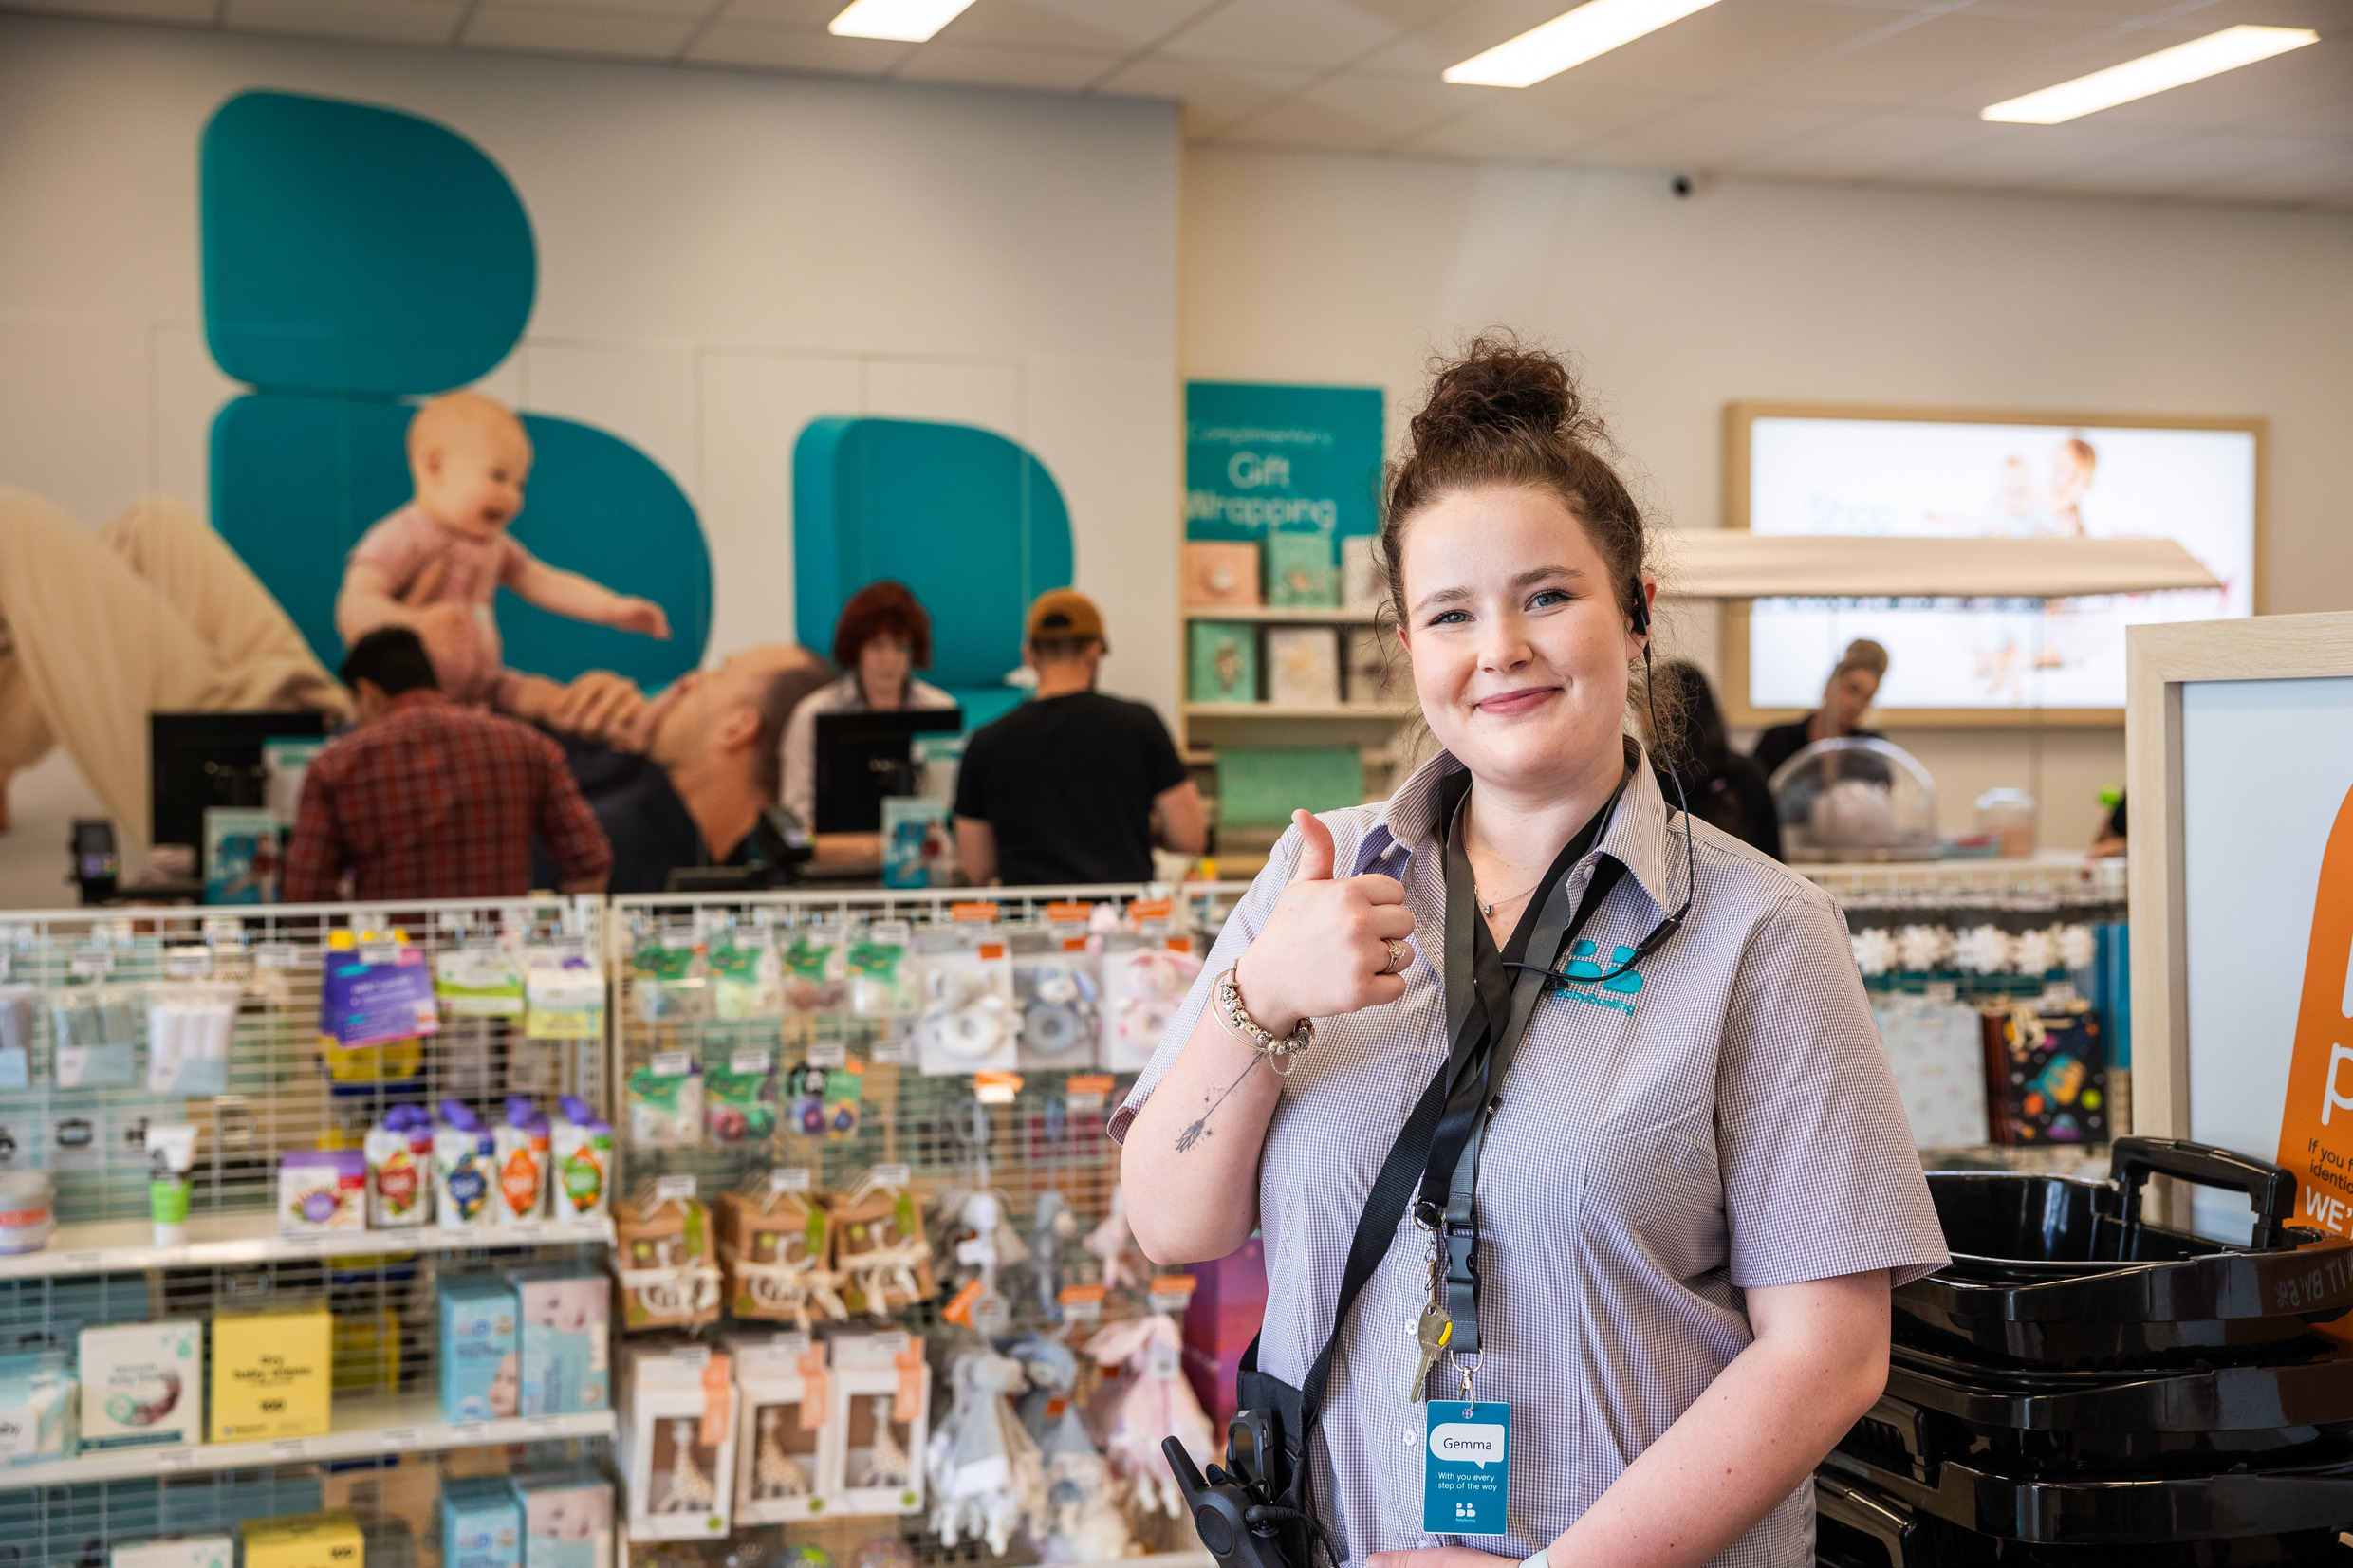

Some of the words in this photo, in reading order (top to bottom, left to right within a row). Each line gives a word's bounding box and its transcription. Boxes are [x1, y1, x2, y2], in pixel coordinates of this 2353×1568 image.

[1227, 451, 1291, 489] Gift
[2308, 1137, 2319, 1154] If
[2319, 1147, 2344, 1169] you
[2306, 1185, 2353, 1240] WE'
[1443, 1437, 1492, 1450] Gemma
[1437, 1471, 1455, 1481] With
[1456, 1473, 1472, 1482] you
[1473, 1474, 1495, 1483] every
[1437, 1482, 1454, 1490] step
[1466, 1482, 1479, 1490] the
[1481, 1484, 1497, 1492] way
